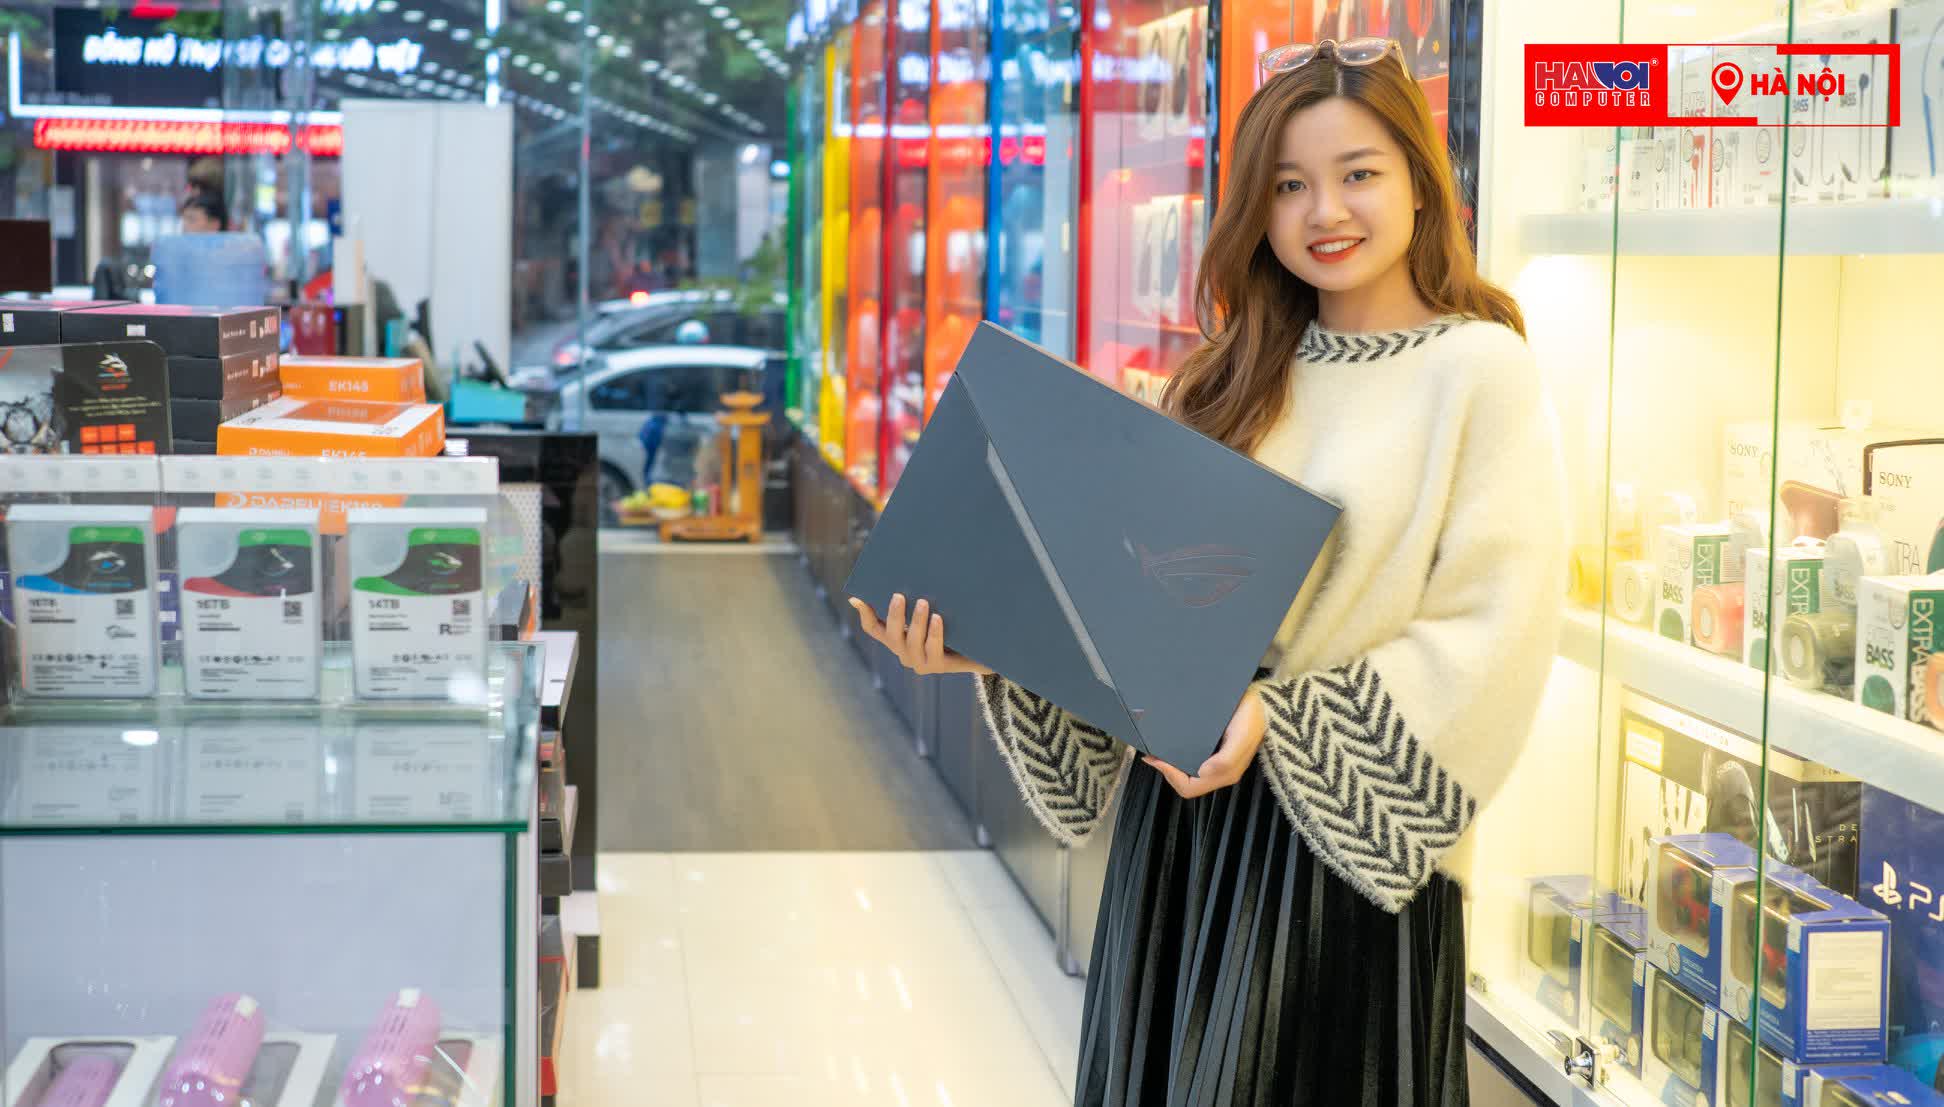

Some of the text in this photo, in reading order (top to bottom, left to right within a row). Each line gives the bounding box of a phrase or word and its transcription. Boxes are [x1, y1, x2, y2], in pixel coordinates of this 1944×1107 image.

[1879, 470, 1913, 488] SONY
[1696, 543, 1713, 589] EXTR
[1791, 568, 1809, 616] EXTR
[1865, 642, 1896, 672] BASS
[1814, 835, 1858, 844] STRA
[1839, 823, 1858, 832] DE
